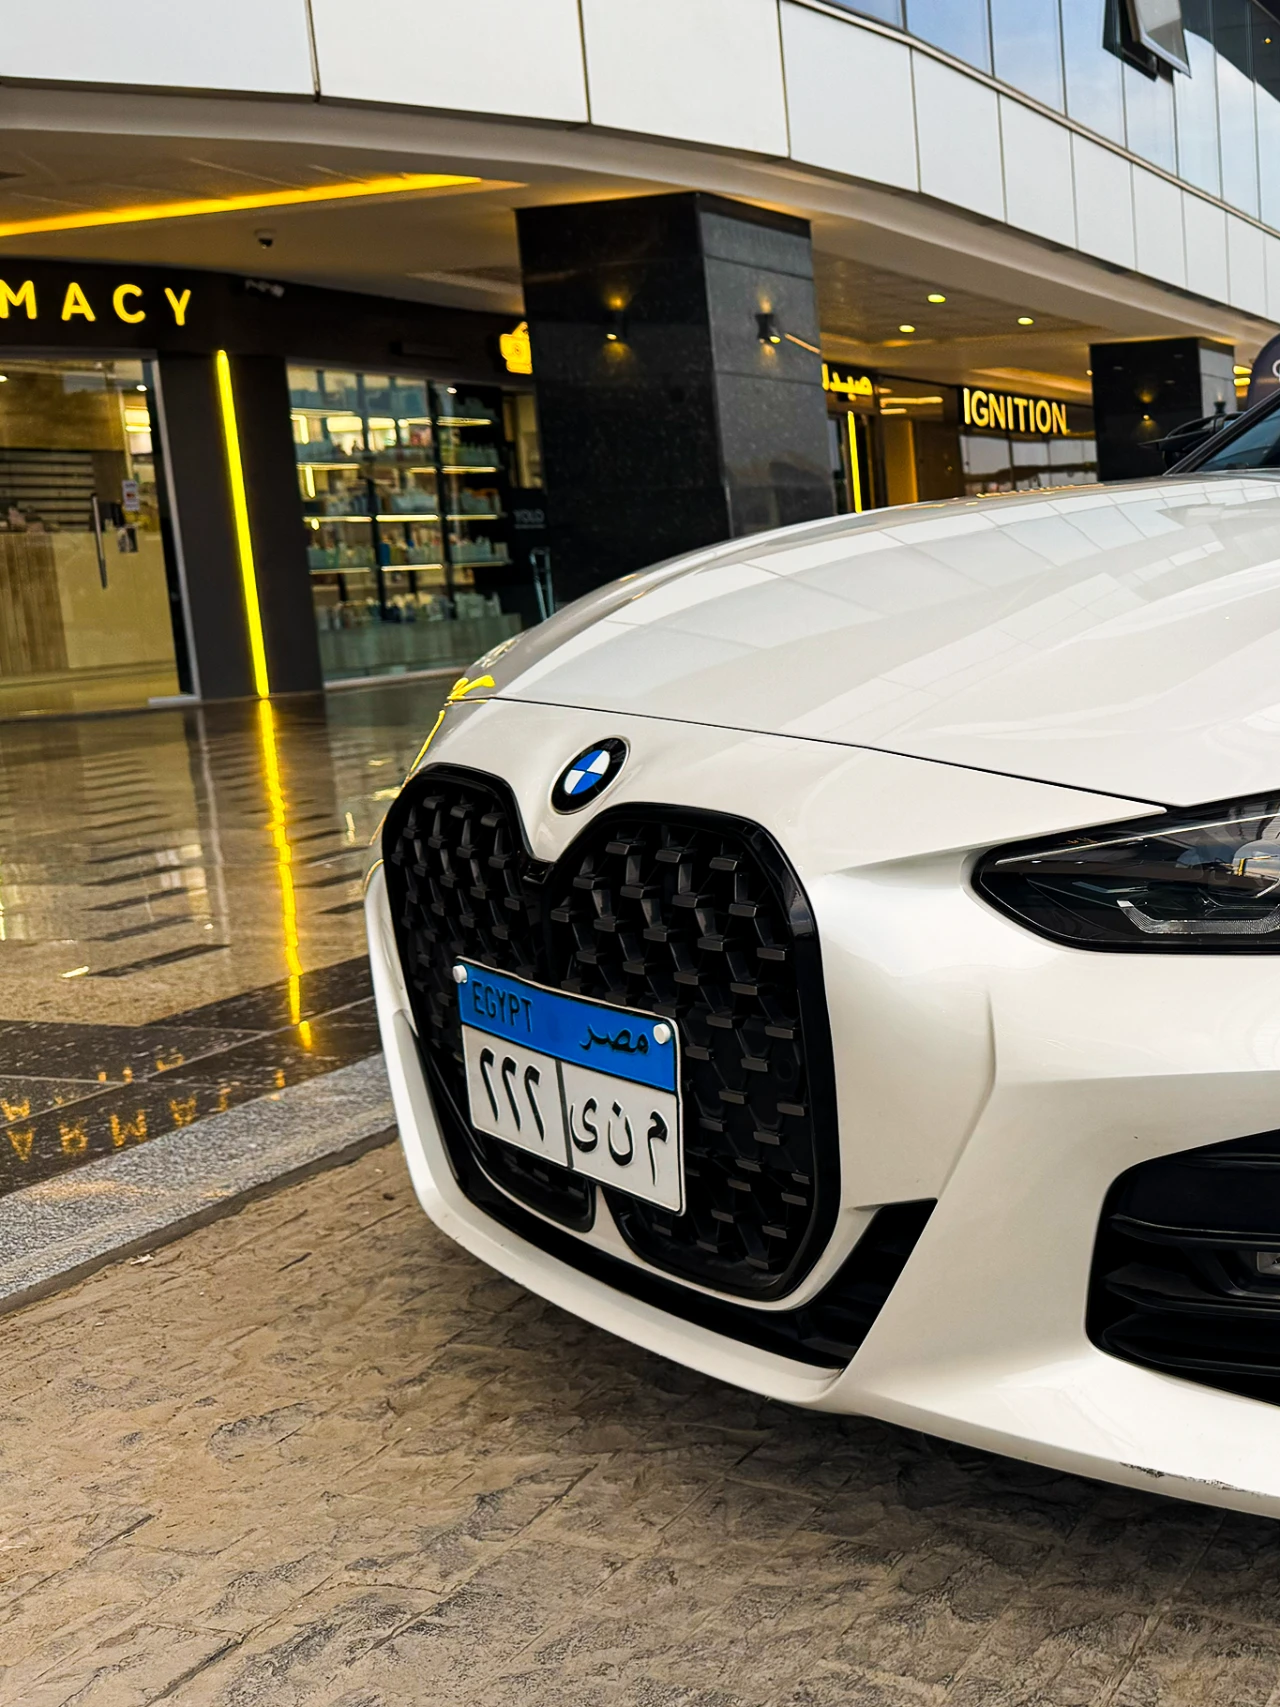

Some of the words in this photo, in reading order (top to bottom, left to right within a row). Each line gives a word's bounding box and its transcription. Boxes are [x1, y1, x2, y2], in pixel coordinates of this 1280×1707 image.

[0, 279, 191, 326] MACY
[963, 387, 1067, 436] IGNITION
[472, 980, 533, 1033] EGYPT
[579, 1024, 650, 1055] مصر
